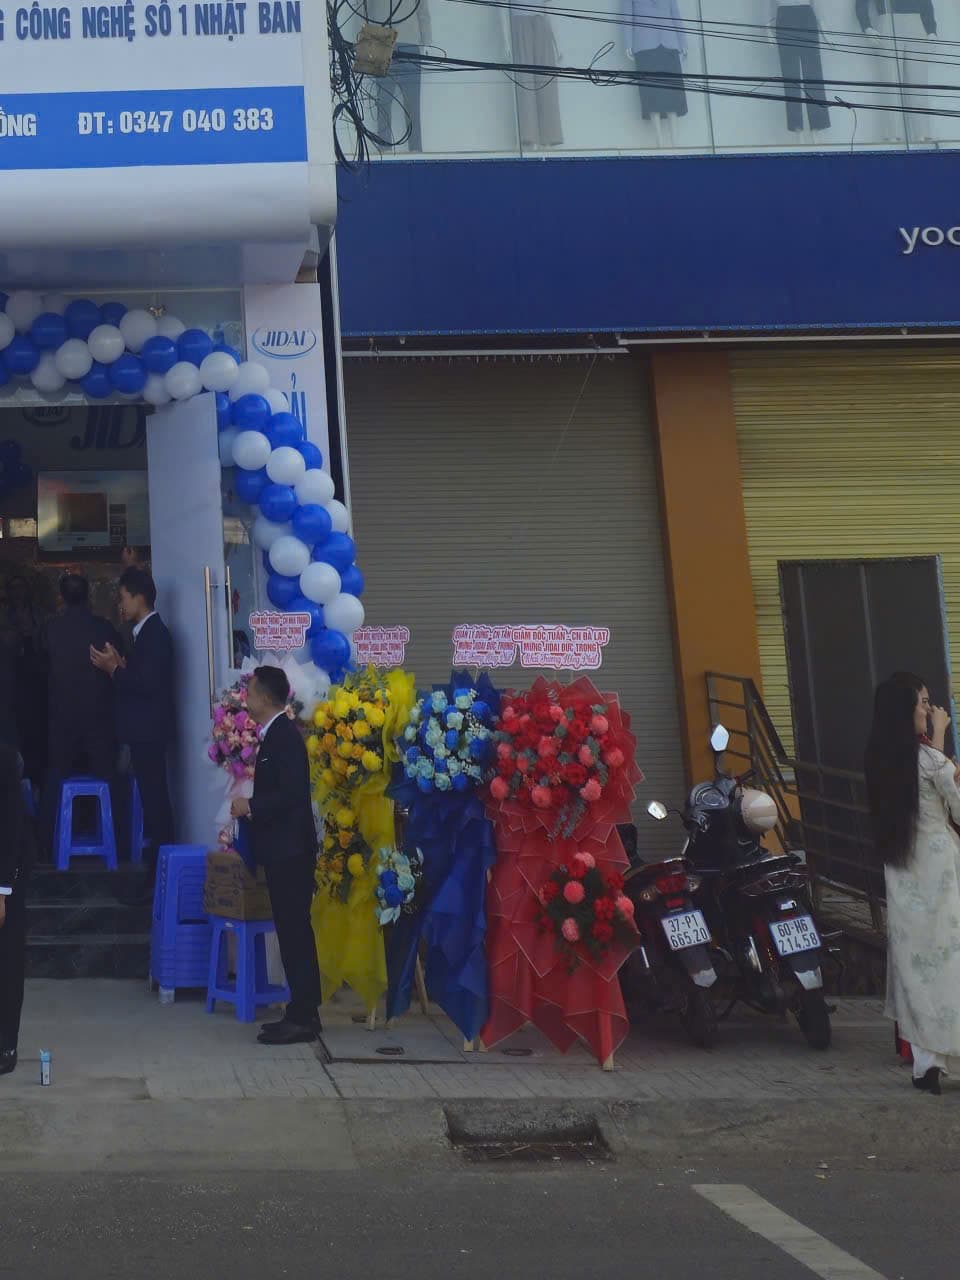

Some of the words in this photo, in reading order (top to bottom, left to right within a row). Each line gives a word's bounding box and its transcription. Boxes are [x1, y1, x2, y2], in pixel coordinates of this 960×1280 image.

[16, 0, 71, 40] CÔNG
[178, 4, 188, 36] 1
[77, 111, 114, 135] ĐT:
[119, 110, 173, 134] 0347
[182, 108, 226, 132] 040
[233, 107, 274, 131] 383
[262, 330, 307, 347] JIDAI
[667, 914, 699, 933] 37-P1
[777, 919, 808, 938] 60-H6
[670, 927, 709, 949] 665.20
[778, 932, 818, 954] 214.58
